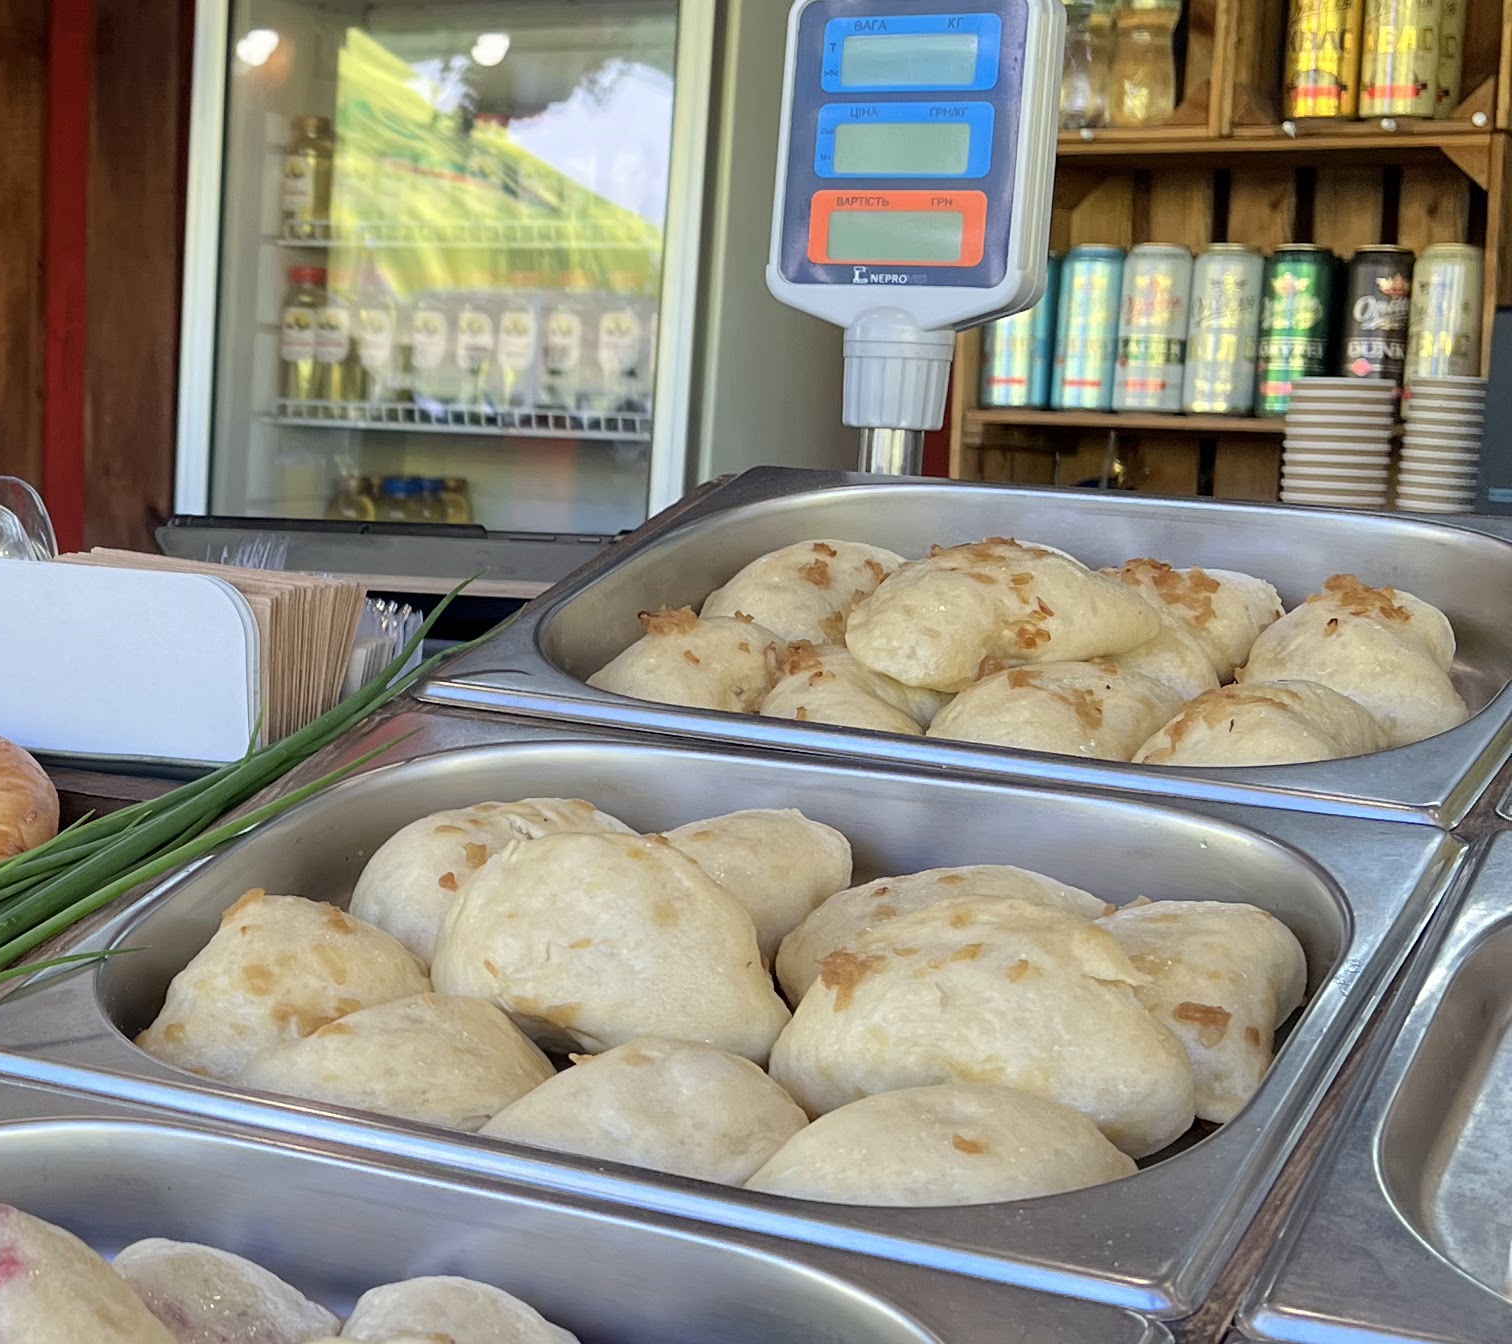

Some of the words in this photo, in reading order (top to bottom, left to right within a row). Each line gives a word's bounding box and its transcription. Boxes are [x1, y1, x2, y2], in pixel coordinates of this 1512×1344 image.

[854, 20, 887, 32] ВАГА
[947, 17, 966, 30] КГ
[850, 107, 879, 120] ЦІНА
[929, 106, 969, 118] ГРН/КГ
[836, 196, 890, 207] ВАРТІСТЬ
[930, 196, 953, 207] ГРН
